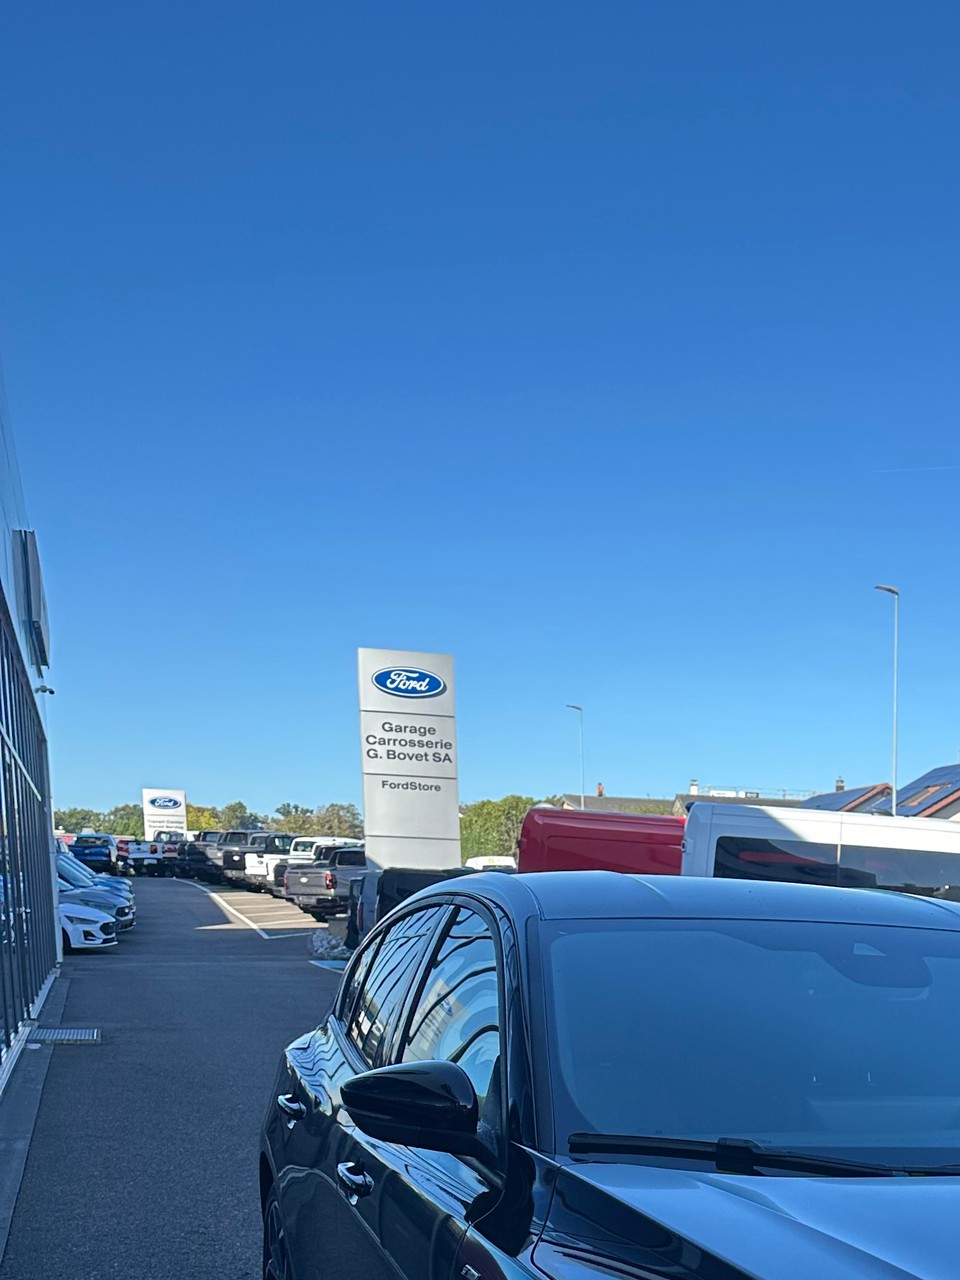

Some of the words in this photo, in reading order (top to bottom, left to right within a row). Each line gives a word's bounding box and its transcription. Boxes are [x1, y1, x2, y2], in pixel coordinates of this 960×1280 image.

[386, 671, 430, 691] Ford
[381, 722, 437, 736] Garage
[365, 734, 453, 750] Carrosserie
[366, 748, 383, 760] G.
[386, 749, 429, 762] Bovet
[432, 752, 453, 763] SA
[381, 780, 442, 792] FordStore
[154, 798, 174, 806] Ford
